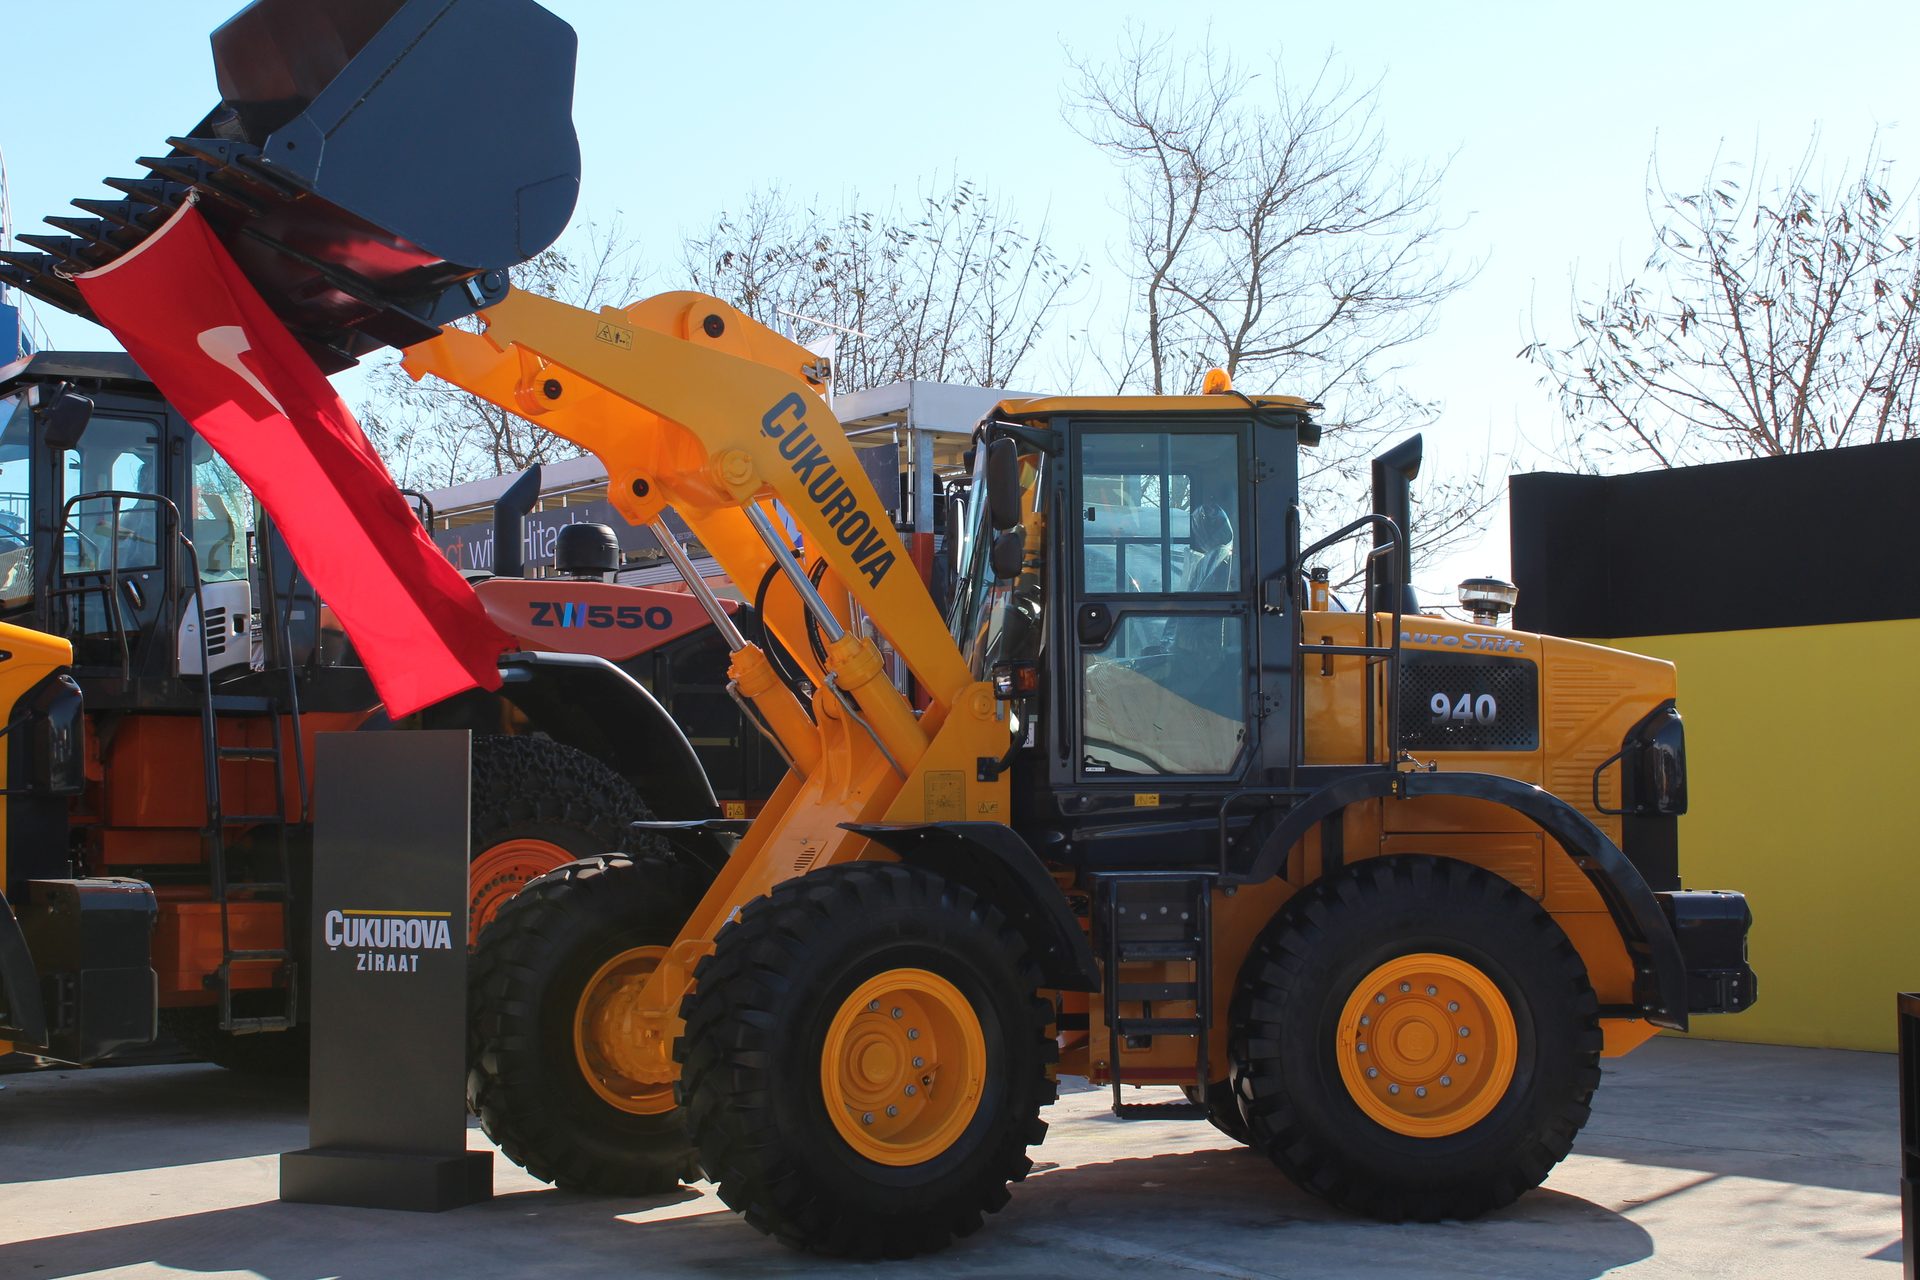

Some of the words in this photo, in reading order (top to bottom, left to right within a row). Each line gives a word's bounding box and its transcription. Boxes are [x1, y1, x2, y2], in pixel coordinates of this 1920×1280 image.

[760, 392, 896, 590] ÇUKUROVA
[469, 529, 495, 569] wit
[529, 601, 673, 631] ZW550
[1430, 692, 1497, 726] 940
[325, 909, 452, 951] ÇUKUROVA
